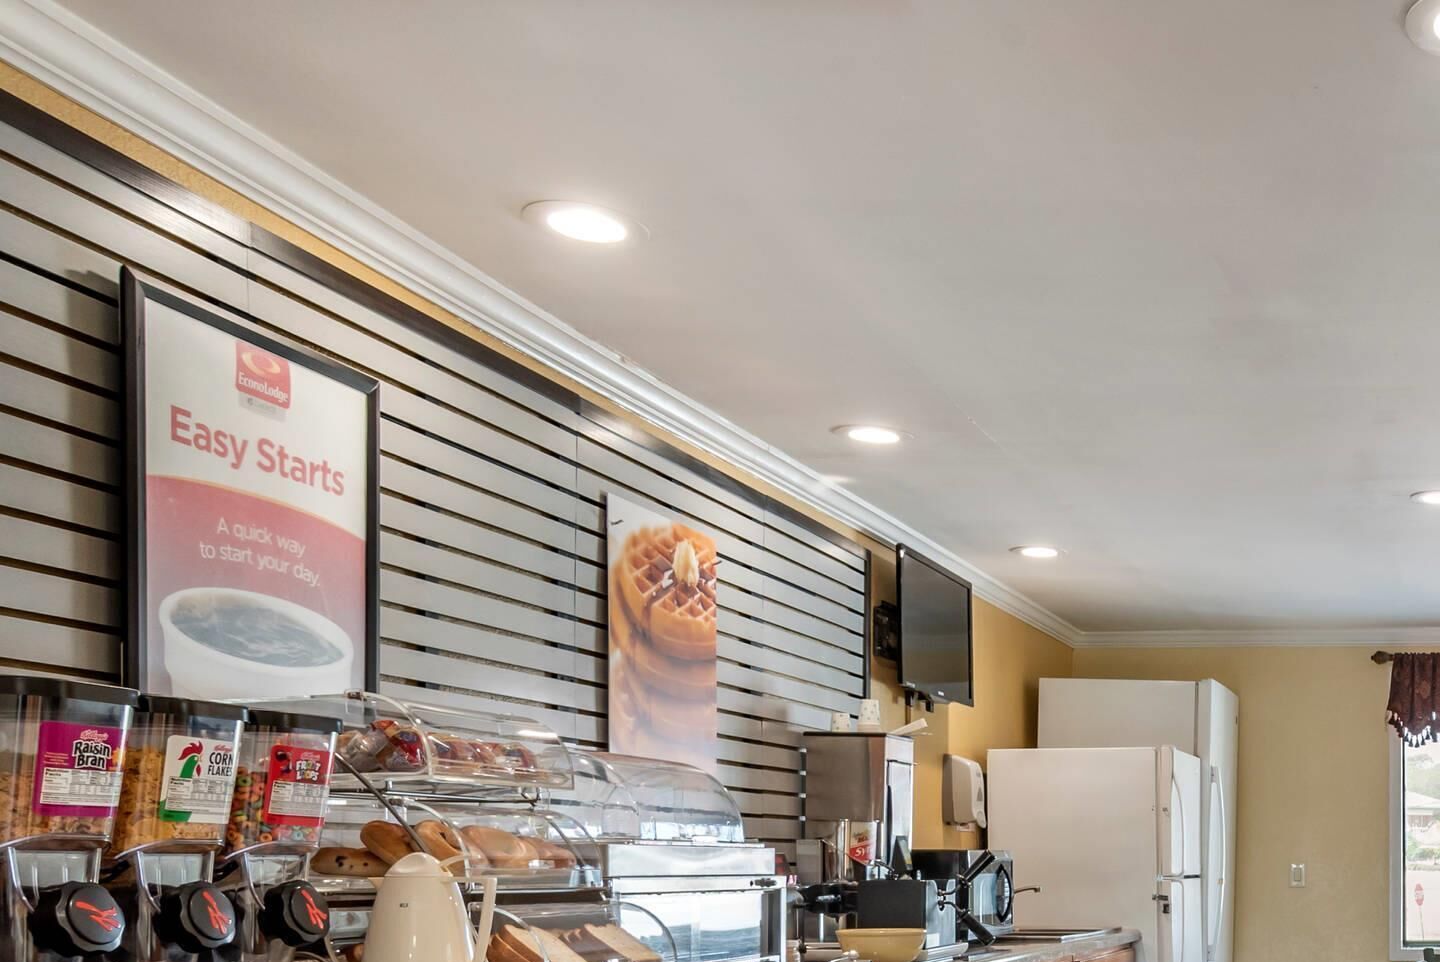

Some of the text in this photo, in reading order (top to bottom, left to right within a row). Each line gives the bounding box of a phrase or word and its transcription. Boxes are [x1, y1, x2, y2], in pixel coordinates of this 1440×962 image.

[170, 404, 345, 497] Easy Starts
[216, 517, 306, 558] A quick way
[200, 542, 321, 587] to start your day.
[74, 740, 111, 758] Raisin
[76, 755, 106, 769] Bran
